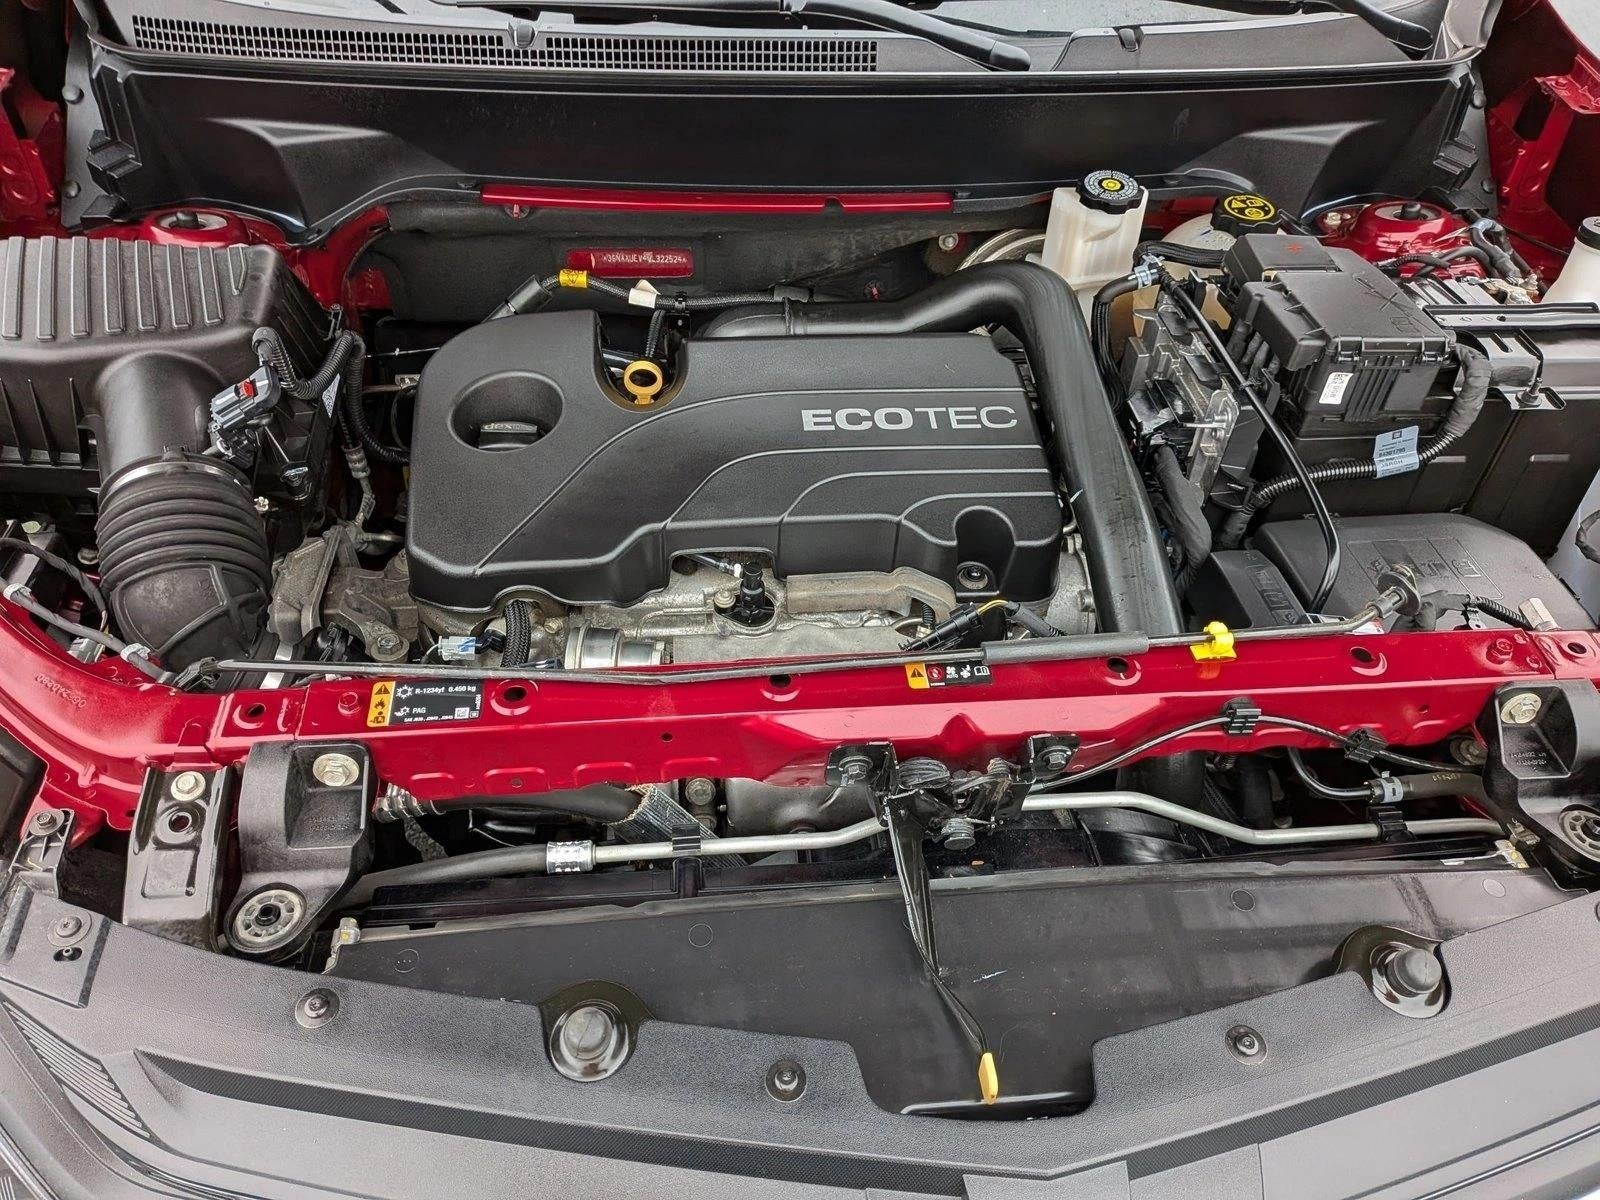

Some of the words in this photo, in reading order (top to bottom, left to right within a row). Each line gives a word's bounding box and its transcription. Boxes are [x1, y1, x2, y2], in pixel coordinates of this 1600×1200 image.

[801, 406, 1018, 431] ECOTEC
[415, 685, 445, 694] R-1234yf
[448, 685, 467, 693] 0.450
